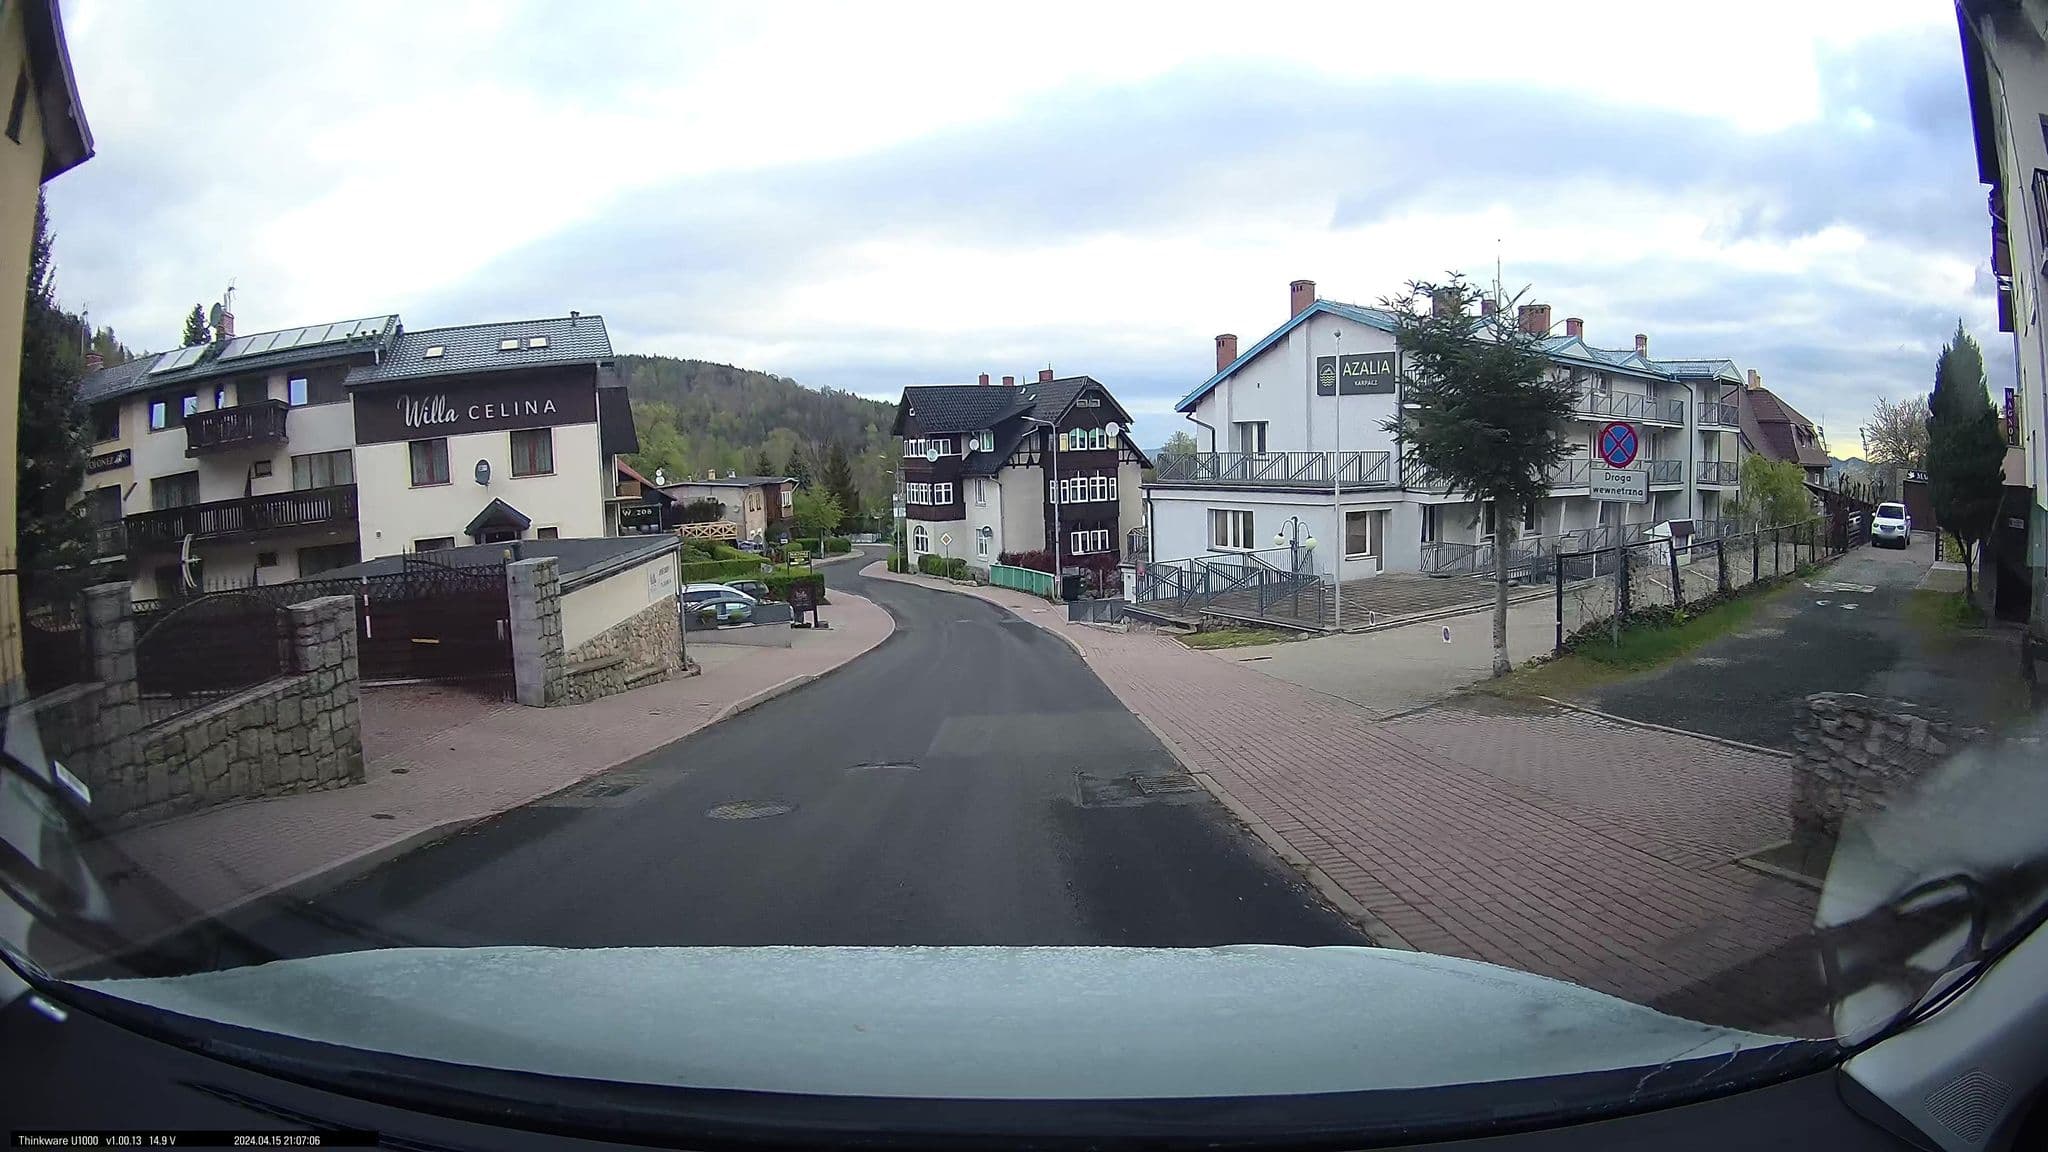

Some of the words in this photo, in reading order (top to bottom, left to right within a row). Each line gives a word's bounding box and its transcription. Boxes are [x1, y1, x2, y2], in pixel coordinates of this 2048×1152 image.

[1342, 360, 1391, 377] AZALIA
[397, 394, 459, 427] Willa
[468, 400, 557, 420] CELINA
[1604, 472, 1632, 484] Droga
